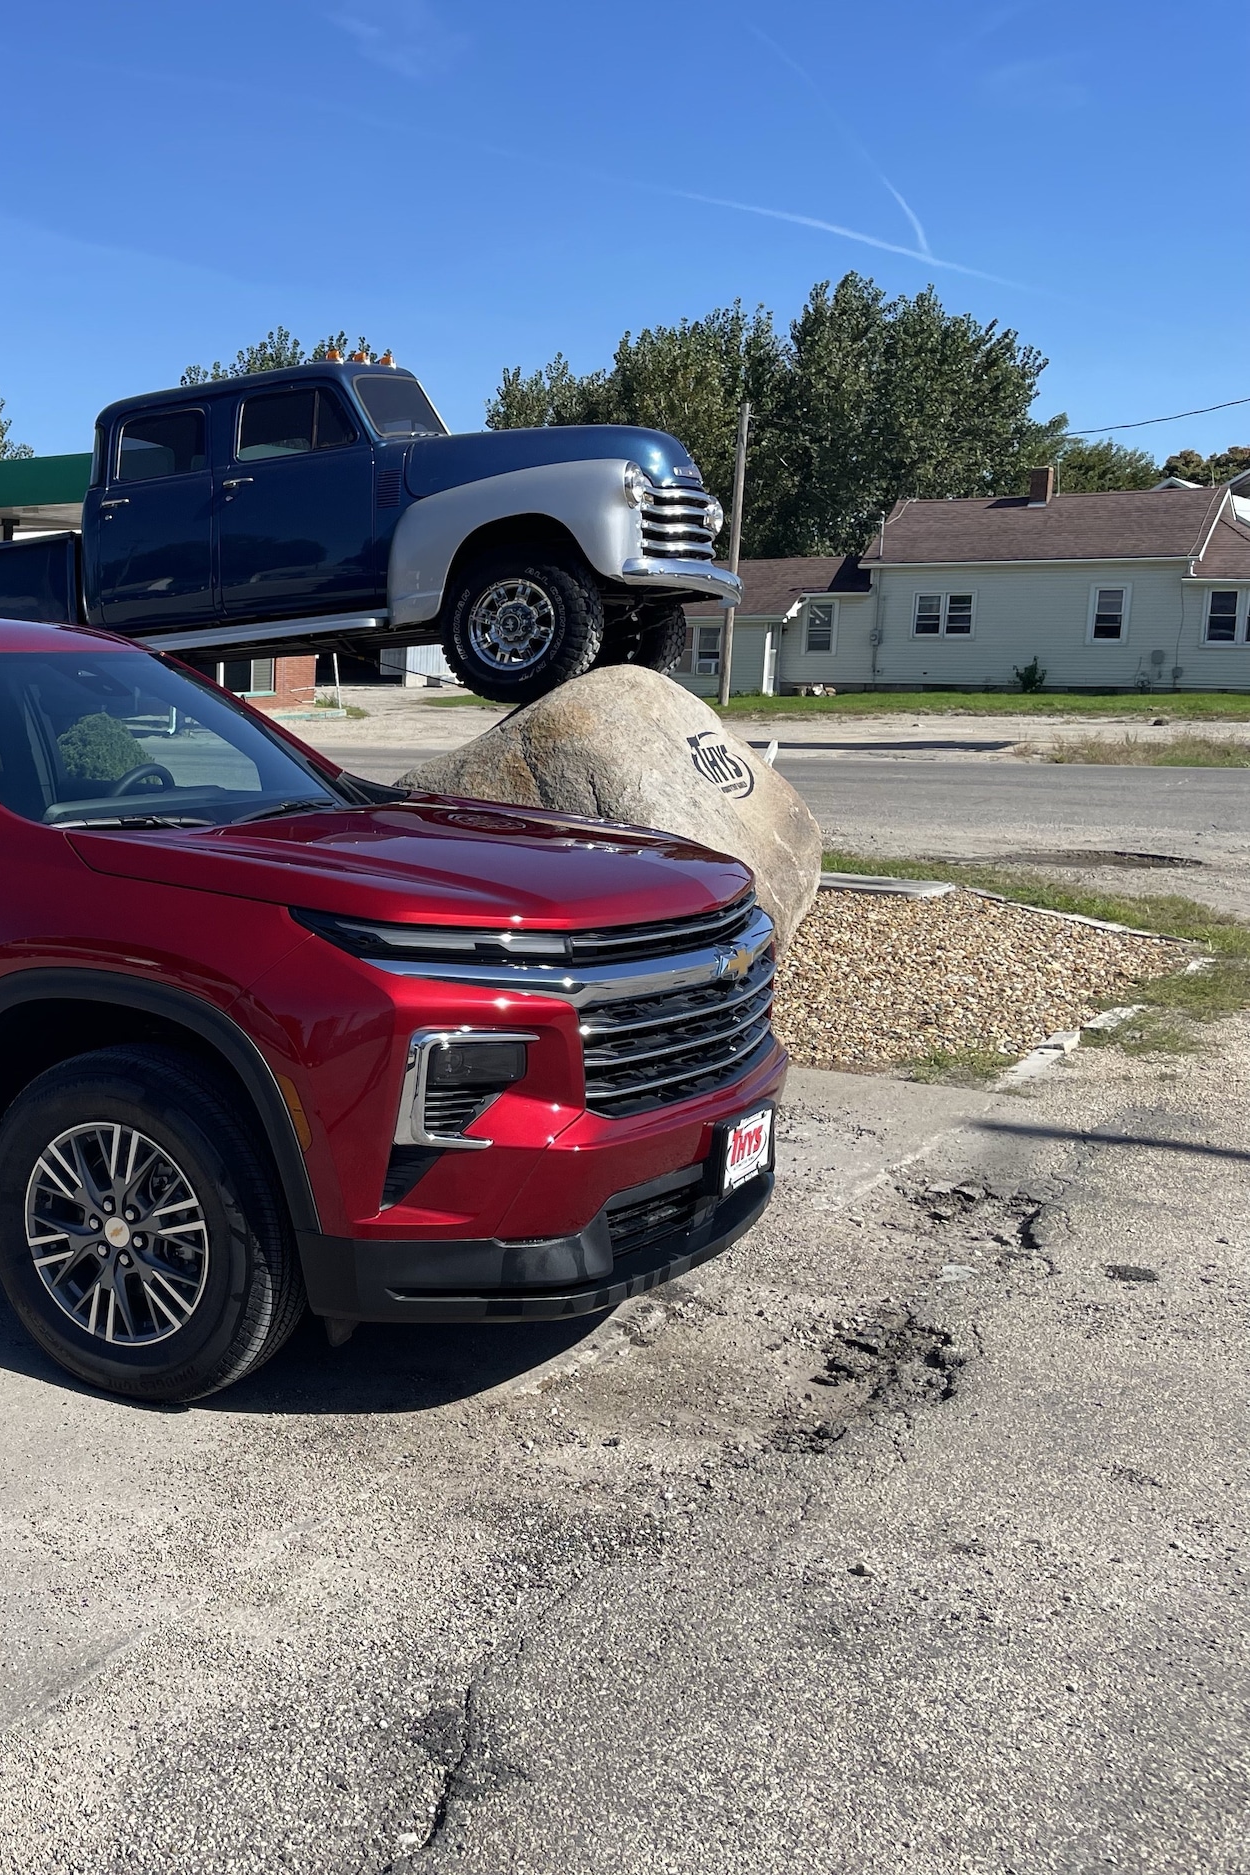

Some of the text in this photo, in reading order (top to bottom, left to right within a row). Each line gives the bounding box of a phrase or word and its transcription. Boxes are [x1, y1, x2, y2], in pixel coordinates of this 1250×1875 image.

[524, 566, 548, 585] ALL
[453, 588, 471, 661] IRONMAN
[686, 735, 743, 784] THYS
[730, 1124, 764, 1167] THYS
